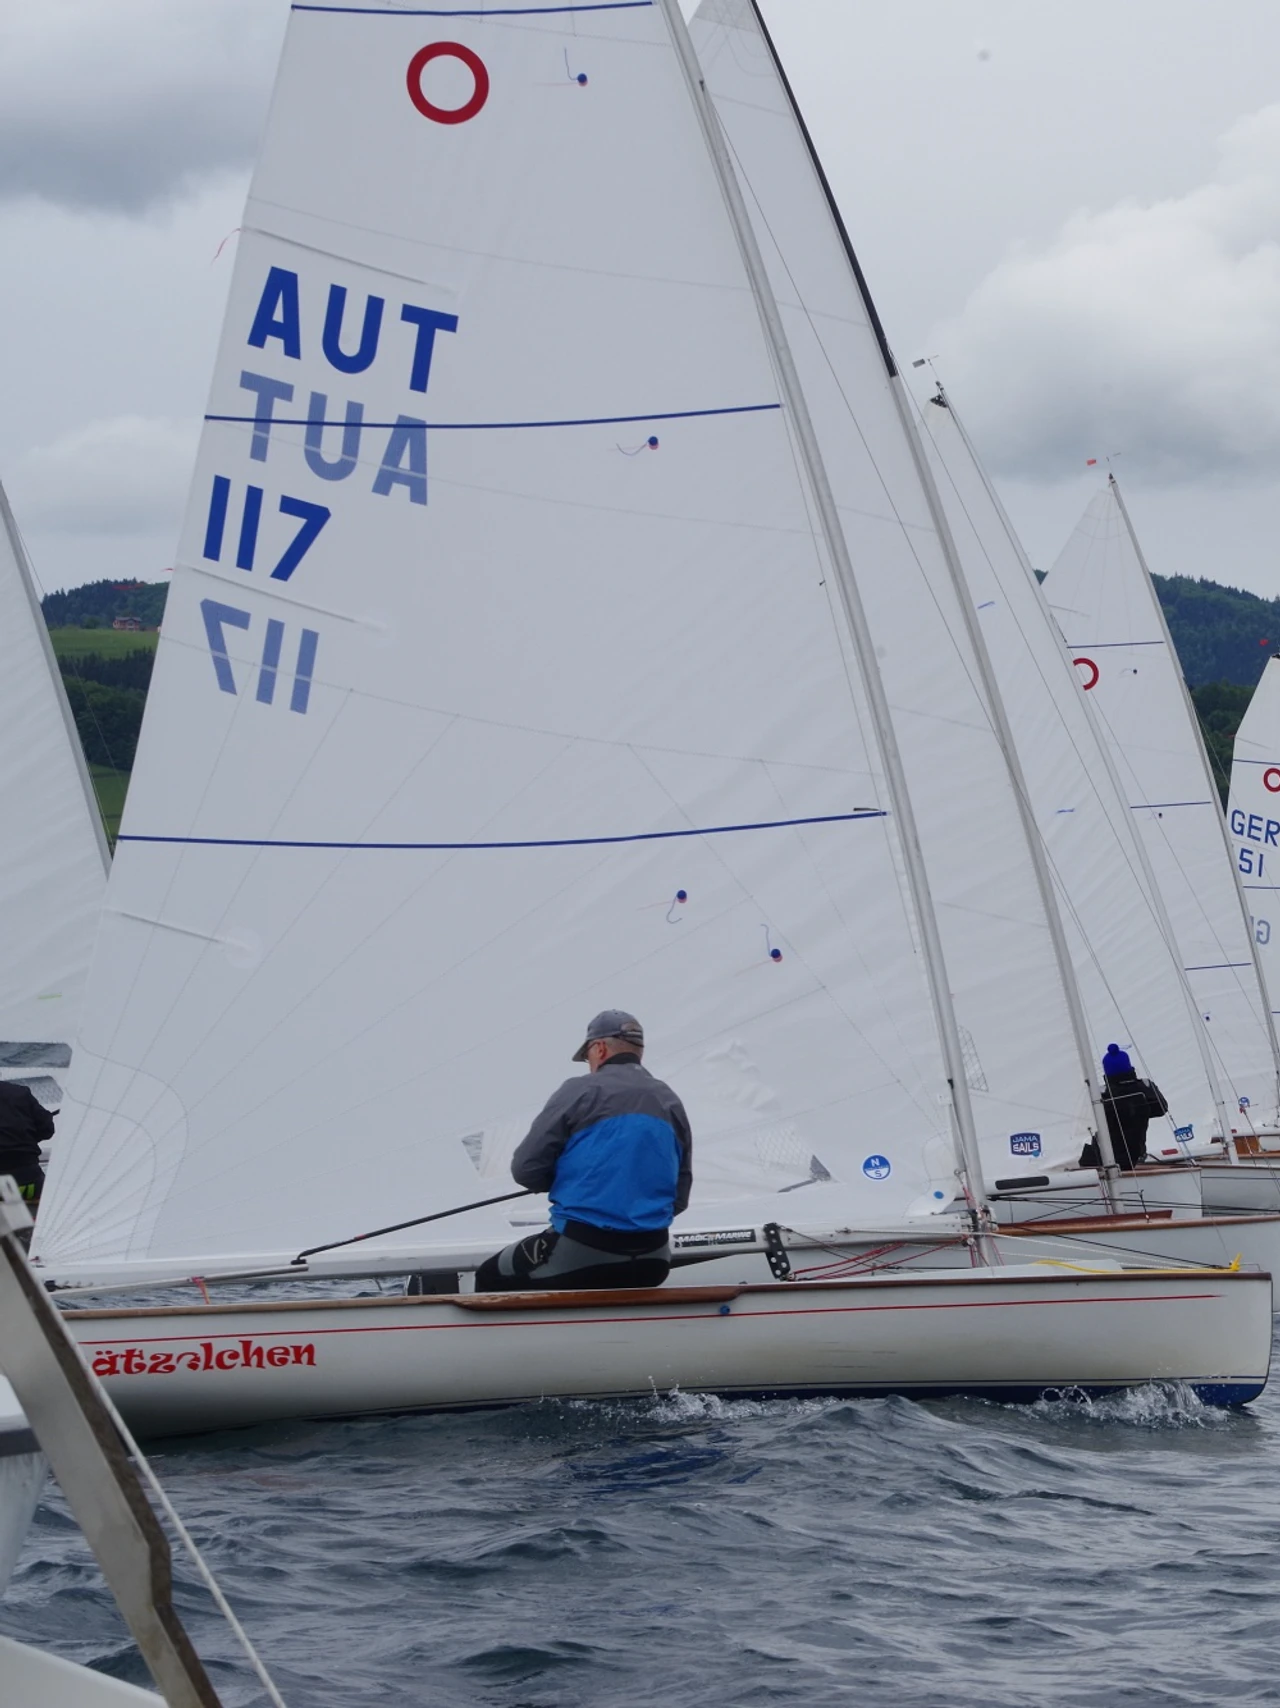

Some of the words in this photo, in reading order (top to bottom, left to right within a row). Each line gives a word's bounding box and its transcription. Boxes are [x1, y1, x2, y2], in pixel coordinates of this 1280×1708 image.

[247, 266, 459, 394] AUT
[203, 474, 331, 582] 117
[1231, 809, 1280, 847] GER
[1238, 847, 1264, 878] 51
[1012, 1135, 1038, 1143] JAMA
[1012, 1142, 1039, 1153] SAILS
